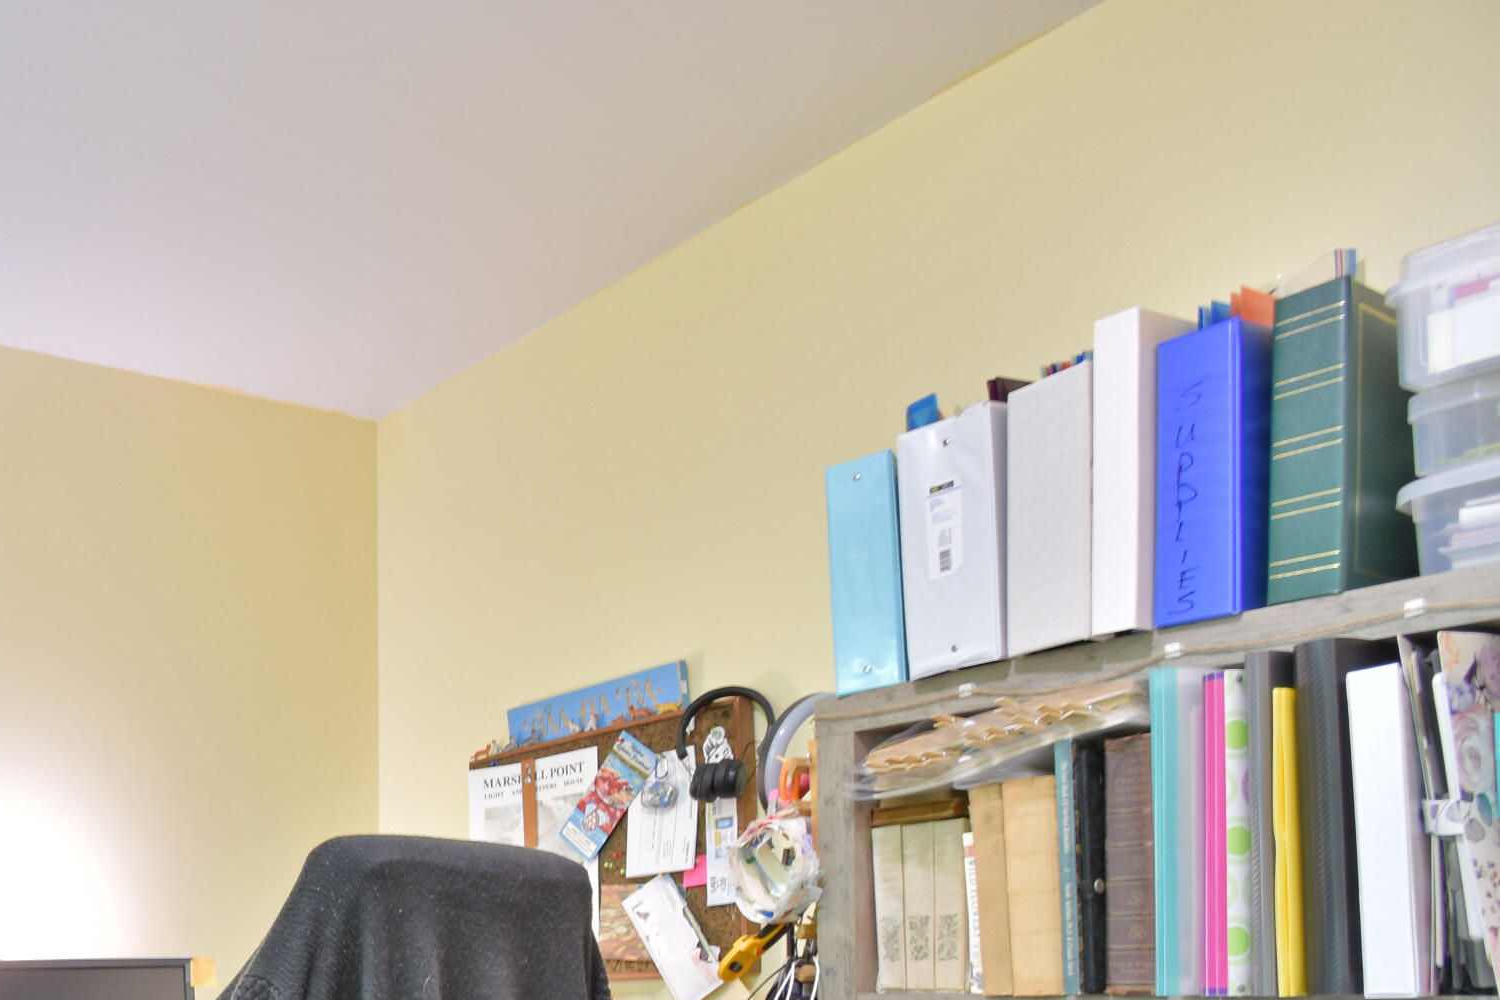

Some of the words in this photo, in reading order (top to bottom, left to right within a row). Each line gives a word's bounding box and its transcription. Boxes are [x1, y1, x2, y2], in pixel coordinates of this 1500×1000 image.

[1167, 380, 1204, 615] SUPPLIES
[483, 769, 548, 789] MARSLL
[550, 761, 585, 778] POINT
[484, 791, 504, 800] LIGHT
